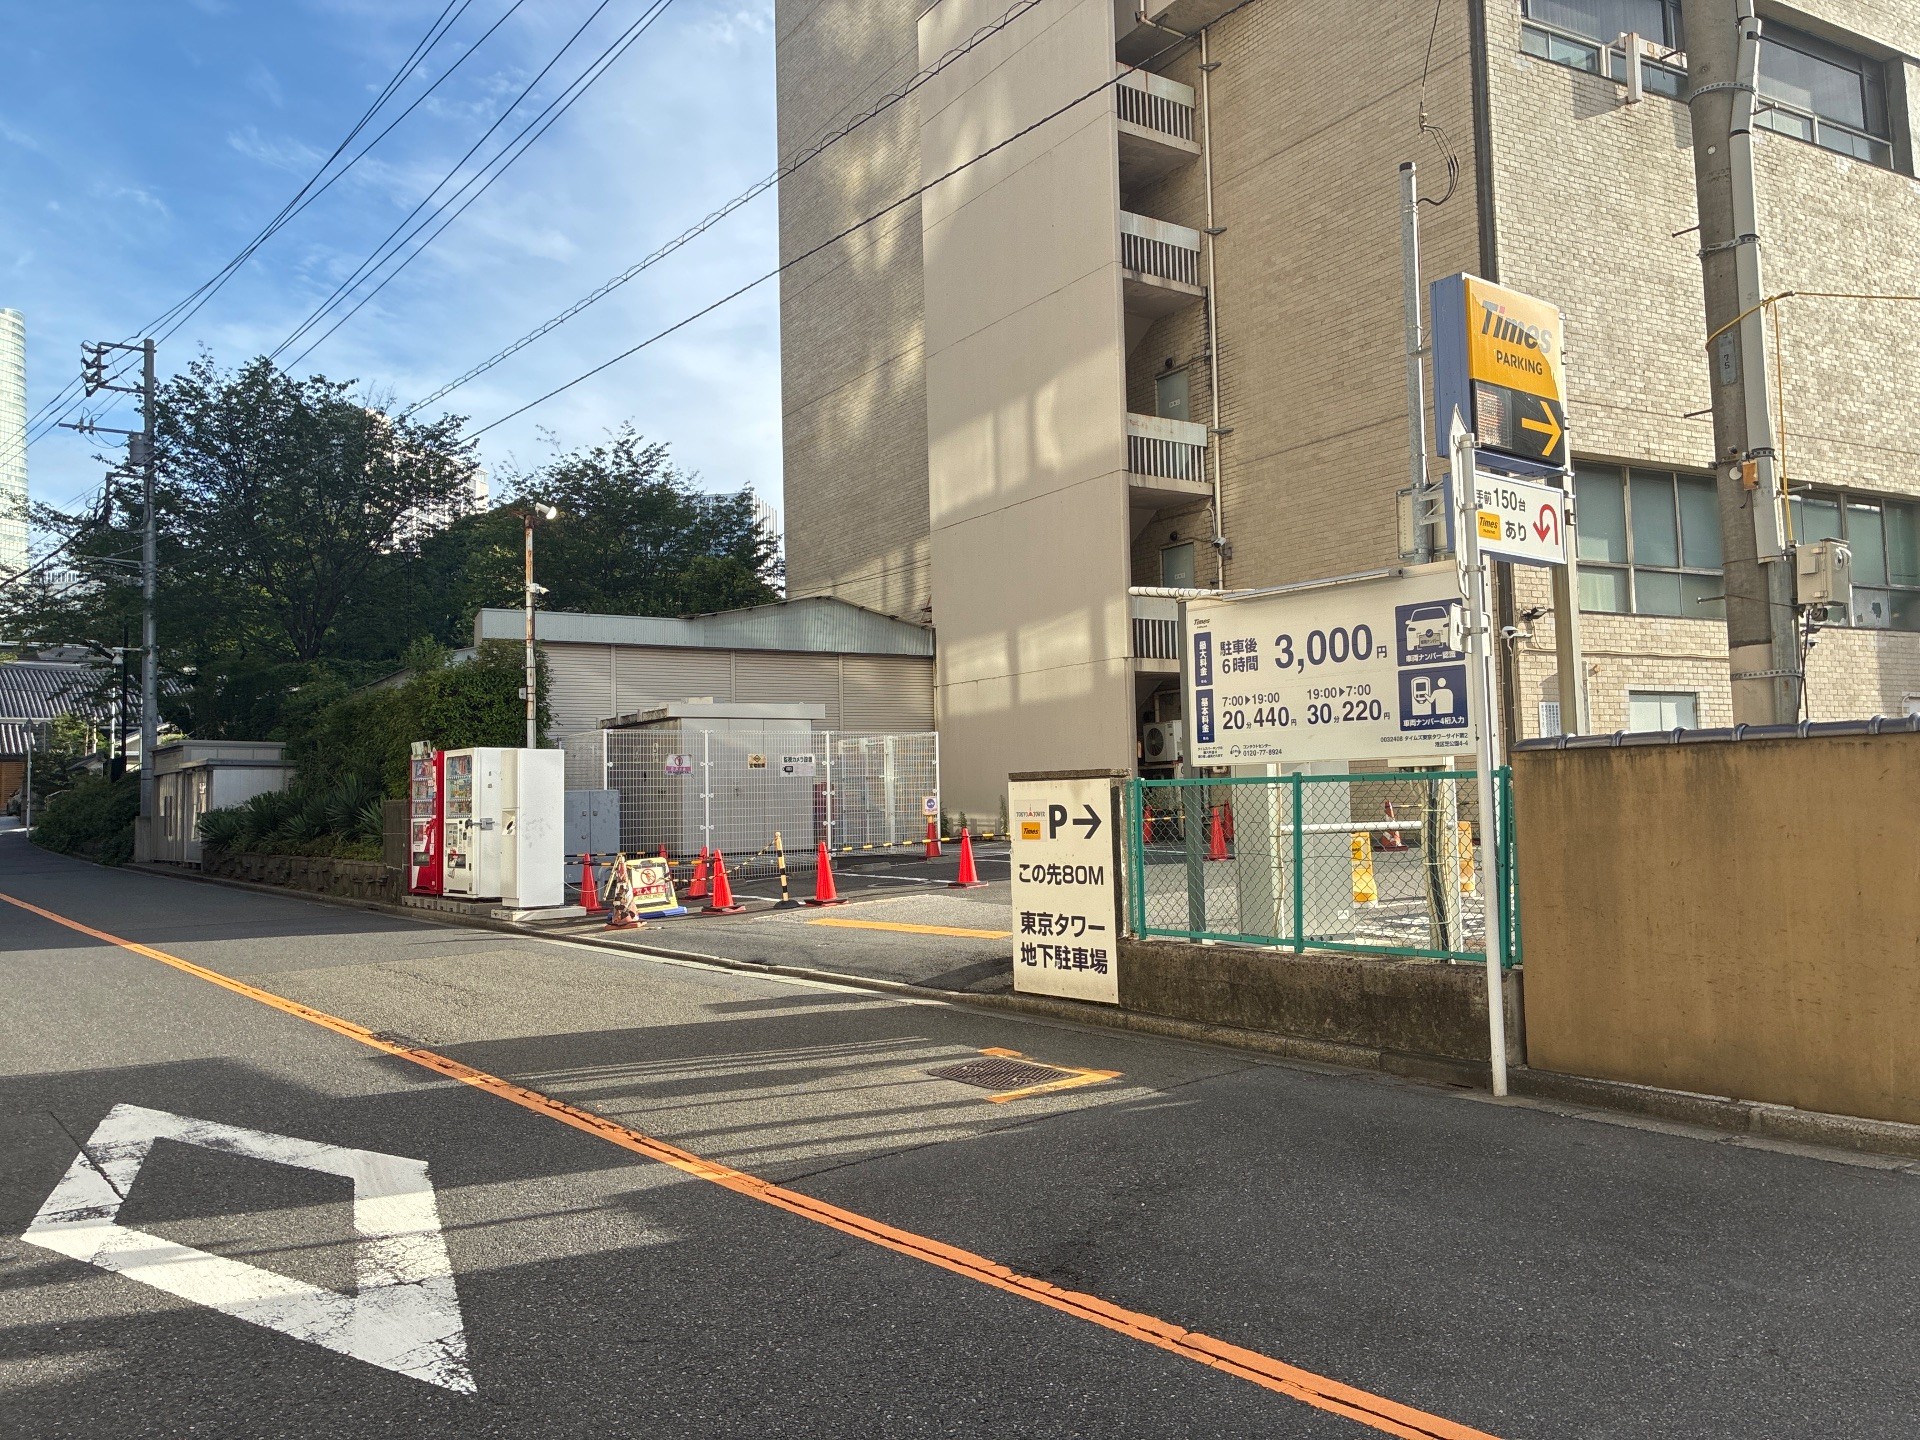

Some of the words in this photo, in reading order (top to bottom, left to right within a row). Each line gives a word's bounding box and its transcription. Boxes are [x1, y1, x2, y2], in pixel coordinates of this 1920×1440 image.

[1481, 299, 1553, 354] Times
[1496, 350, 1543, 375] PARKING
[1479, 516, 1499, 529] Times
[1505, 520, 1527, 542] あり
[1220, 638, 1258, 656] 駐車後
[1274, 623, 1388, 675] 3,000円
[1222, 655, 1259, 674] 6時間
[1222, 695, 1244, 708] 7:00
[1252, 691, 1280, 705] 19:00
[1307, 686, 1338, 701] 19:00
[1346, 683, 1371, 697] 7:00
[1201, 697, 1210, 733] 基本料金
[1403, 715, 1466, 728] 車両ナンバー4桁入力
[1023, 827, 1039, 835] Times
[1048, 804, 1068, 840] P
[1018, 863, 1104, 886] この先80M
[1020, 910, 1106, 938] 東京タワー
[1020, 941, 1108, 975] 地下駐車場
